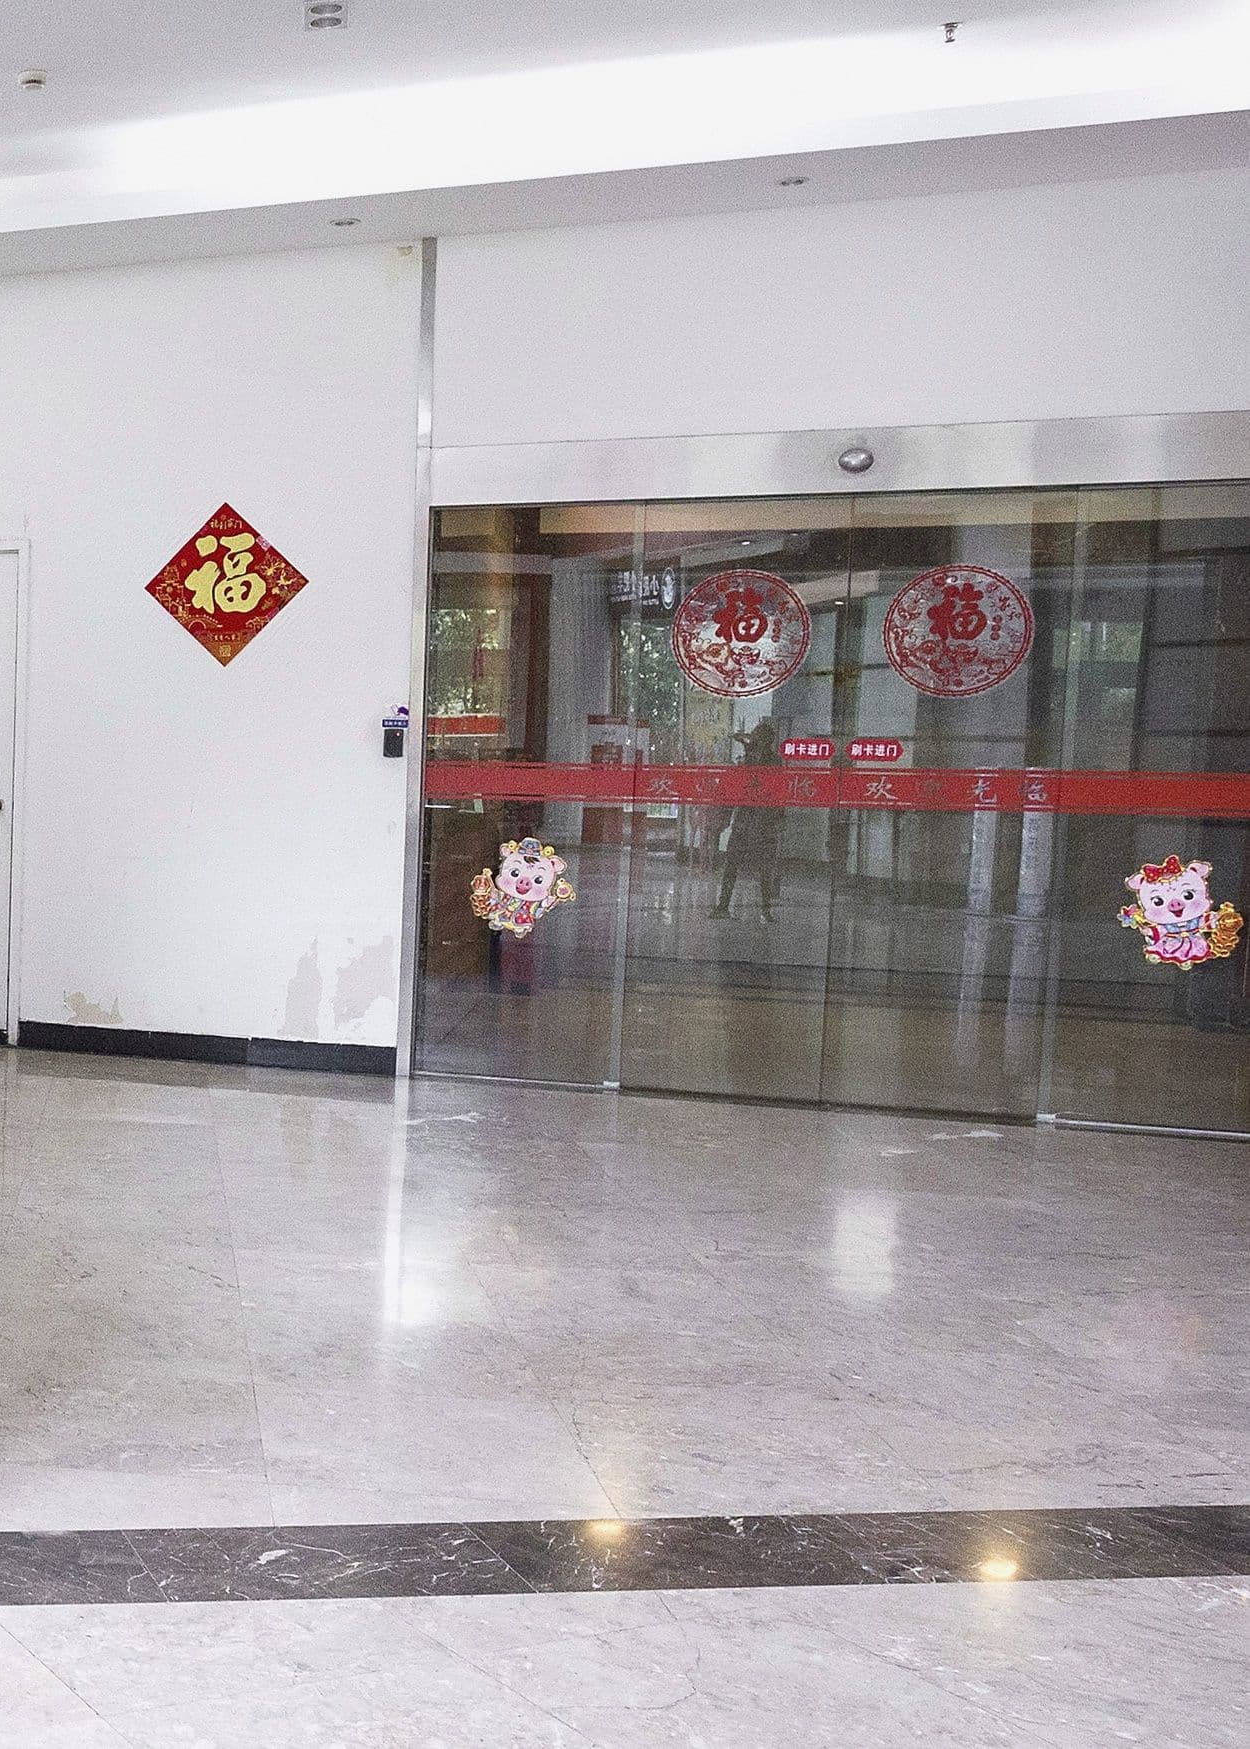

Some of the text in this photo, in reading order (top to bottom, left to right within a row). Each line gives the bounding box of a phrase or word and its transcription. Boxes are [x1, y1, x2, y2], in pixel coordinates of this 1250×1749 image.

[184, 532, 267, 615] 福
[712, 586, 769, 643] 福
[926, 582, 988, 641] 福
[784, 743, 829, 756] 刷卡进门
[851, 743, 897, 757] 刷卡进门
[863, 775, 1048, 802] 欢光临
